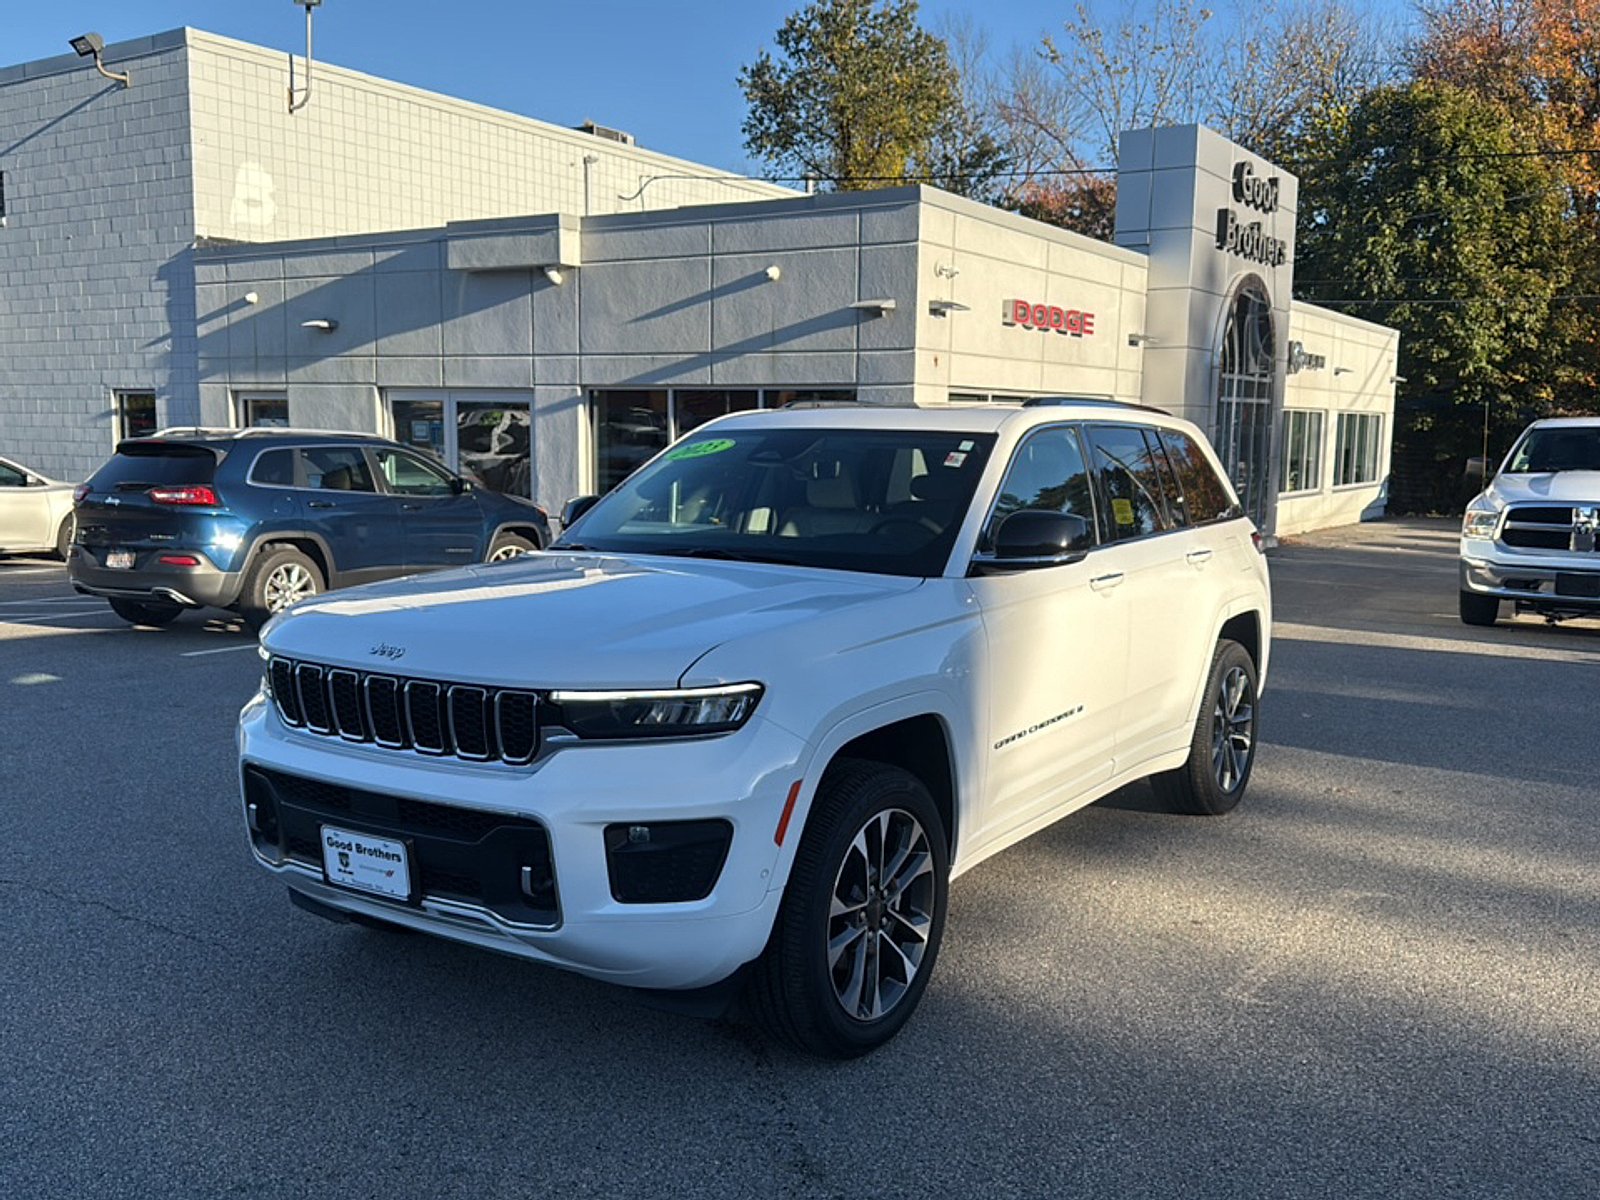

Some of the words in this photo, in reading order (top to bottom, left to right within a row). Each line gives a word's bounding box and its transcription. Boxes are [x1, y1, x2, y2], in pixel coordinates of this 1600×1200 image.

[1232, 160, 1279, 214] Good
[1215, 208, 1287, 267] Brothers
[1006, 299, 1095, 335] DODGE
[369, 643, 406, 661] Jeep
[326, 836, 353, 852] Good
[355, 843, 402, 863] Brothers
